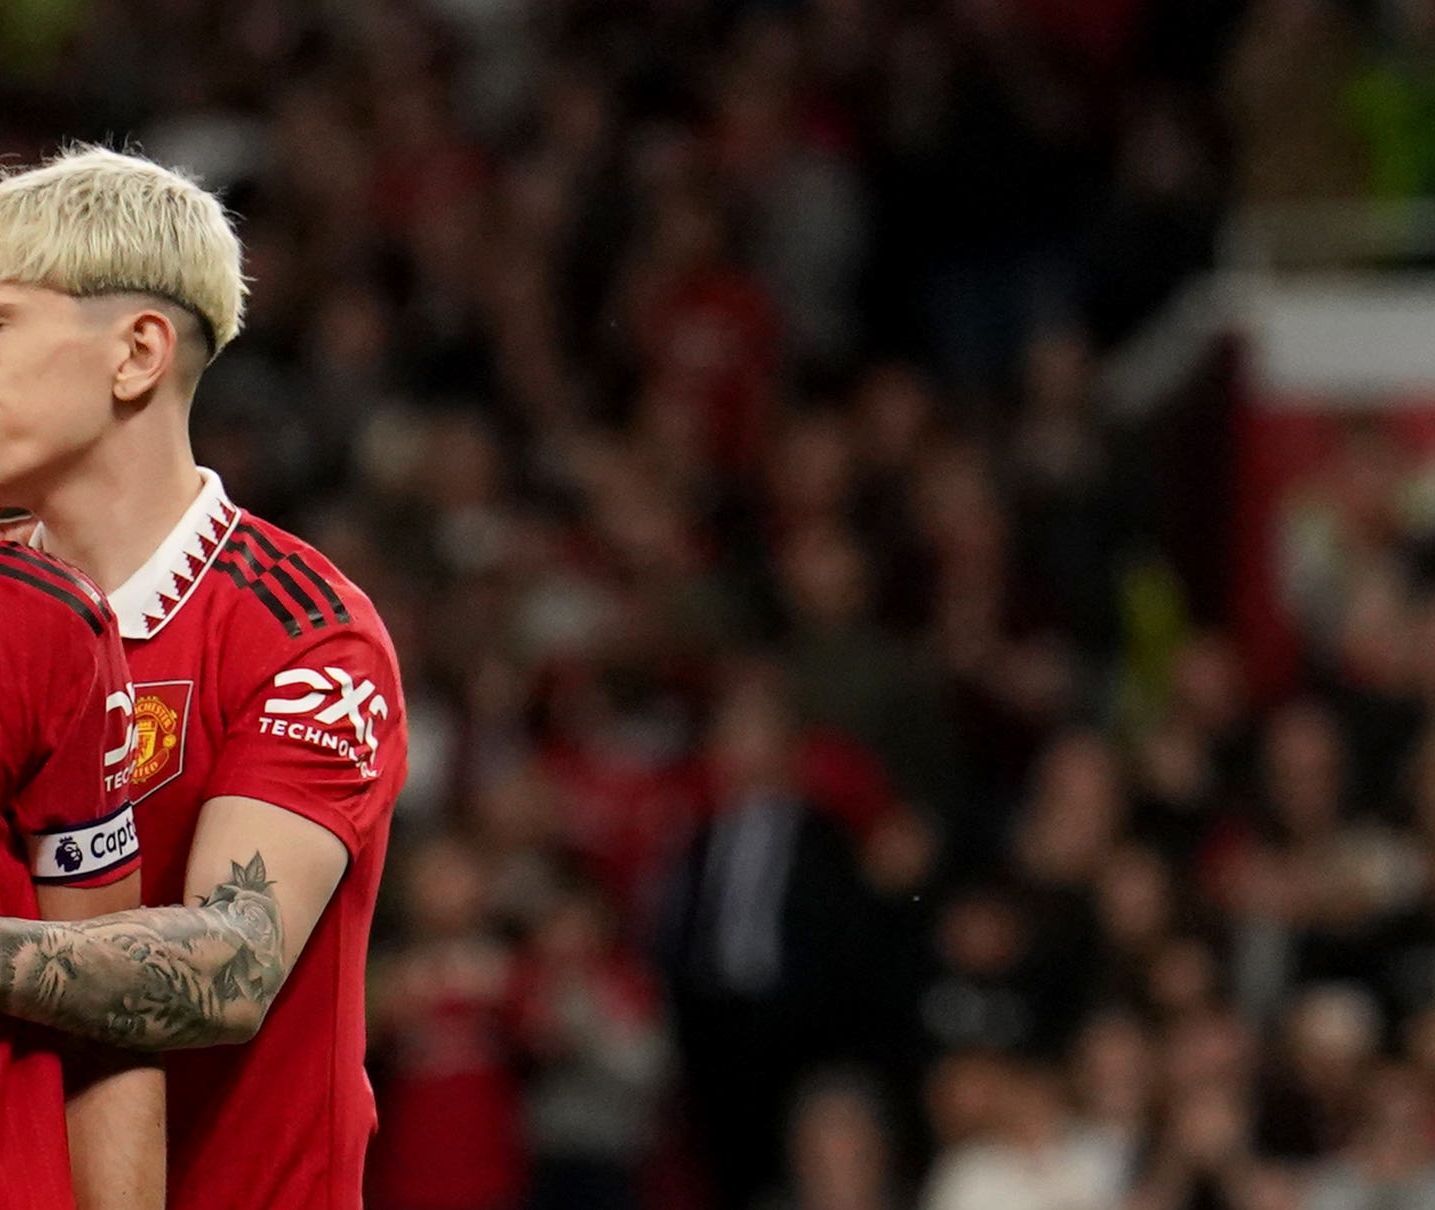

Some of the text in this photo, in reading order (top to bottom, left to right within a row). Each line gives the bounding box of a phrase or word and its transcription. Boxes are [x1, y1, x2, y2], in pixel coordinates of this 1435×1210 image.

[134, 702, 172, 728] CHESTER
[133, 760, 159, 778] ITED
[91, 817, 135, 859] Capt
